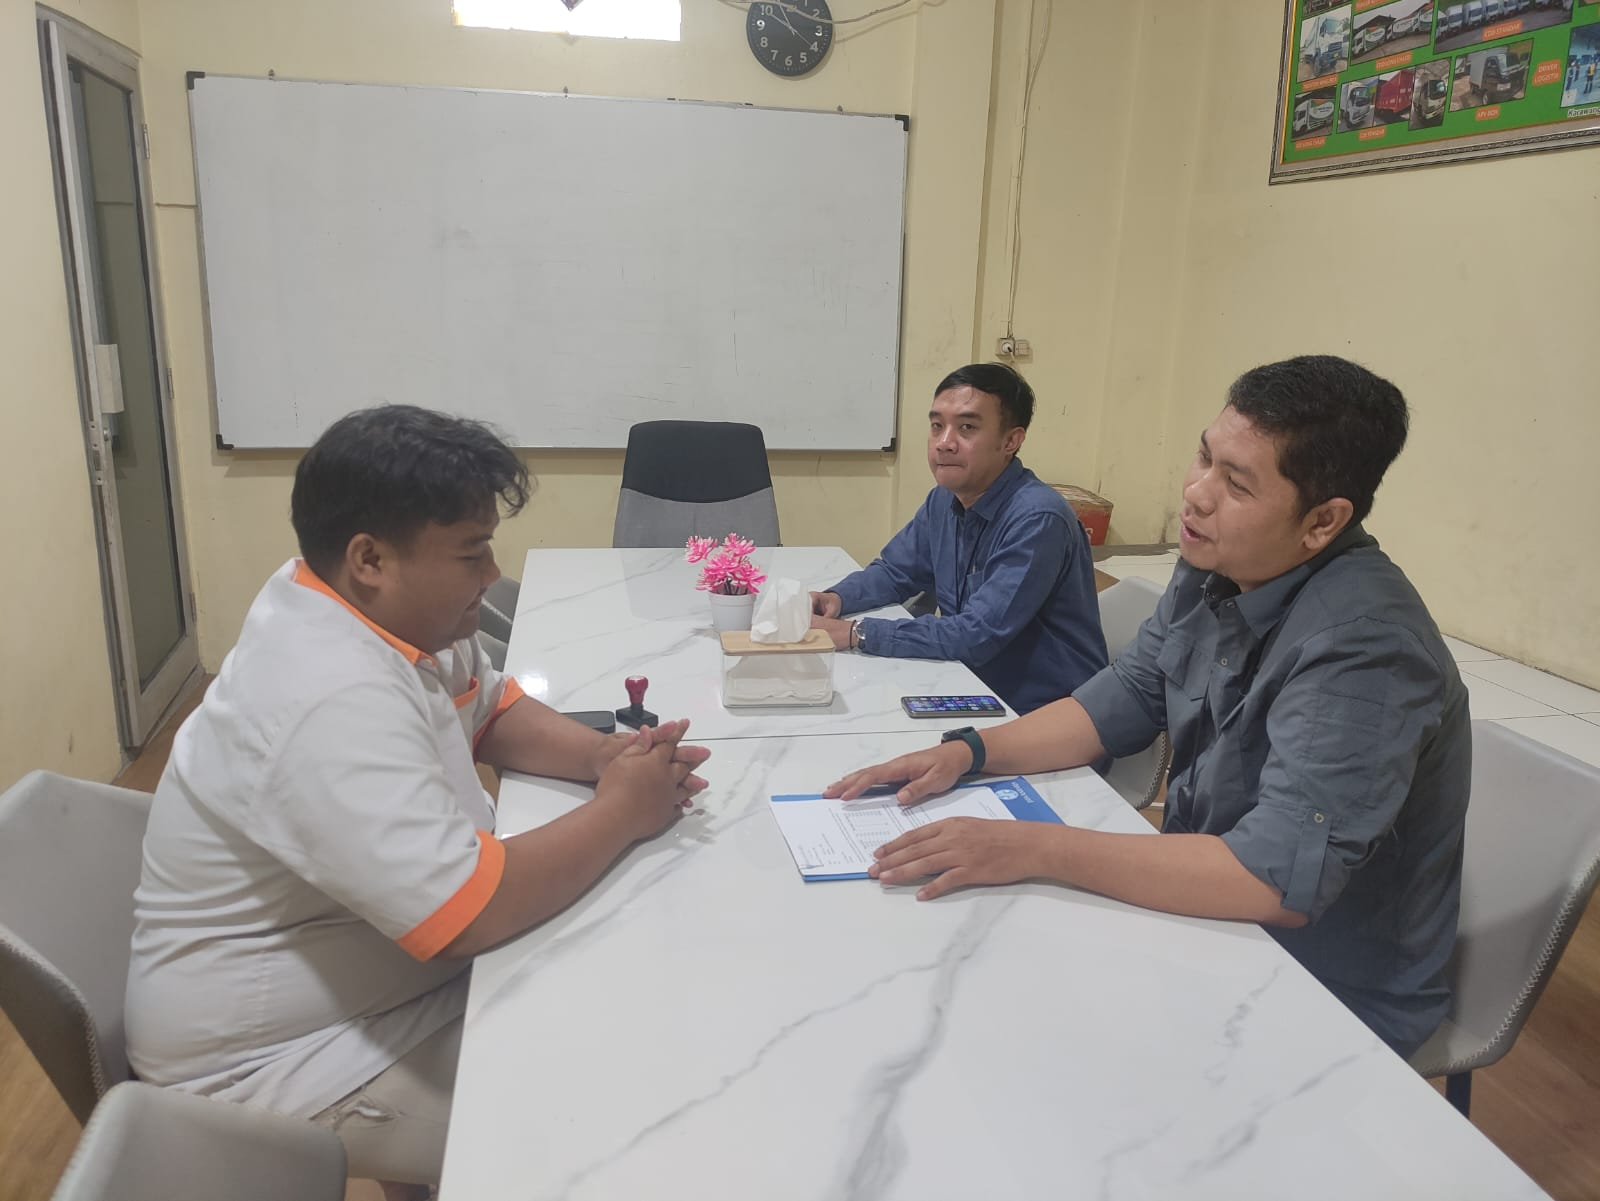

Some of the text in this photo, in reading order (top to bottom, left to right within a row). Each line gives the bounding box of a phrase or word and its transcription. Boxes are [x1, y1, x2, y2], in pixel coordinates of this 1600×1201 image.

[760, 4, 773, 16] 10
[812, 8, 820, 19] 2
[756, 19, 765, 30] 9
[815, 25, 823, 36] 3
[760, 36, 768, 48] 8
[809, 41, 819, 52] 4
[770, 50, 778, 60] 7
[784, 55, 793, 66] 6
[800, 52, 807, 63] 5
